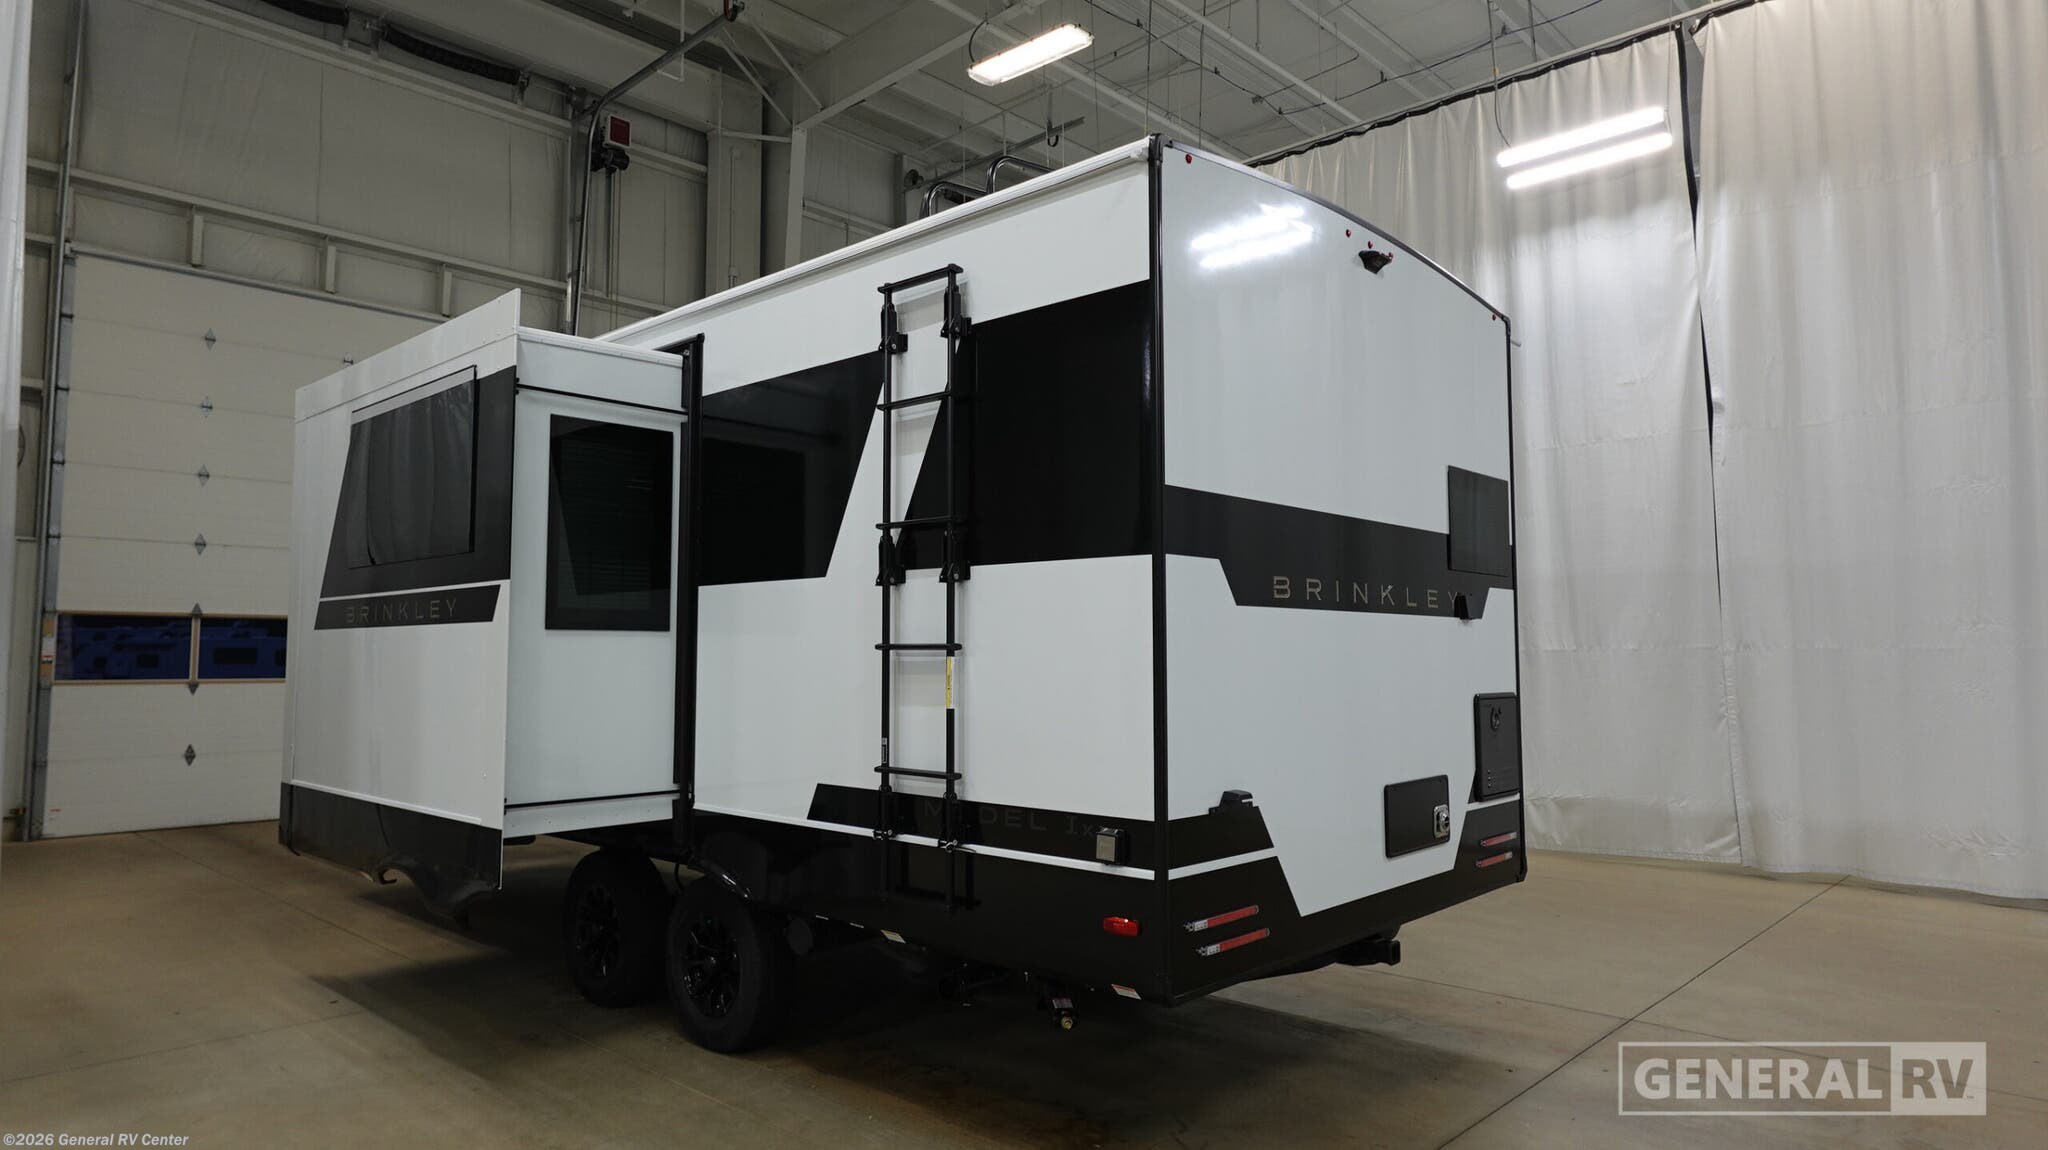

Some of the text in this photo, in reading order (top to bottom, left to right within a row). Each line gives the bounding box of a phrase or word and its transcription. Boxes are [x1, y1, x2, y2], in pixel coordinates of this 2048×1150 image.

[1272, 575, 1458, 610] BRINKLEY
[345, 598, 457, 624] BRINKLEY
[923, 799, 1047, 831] MDEL
